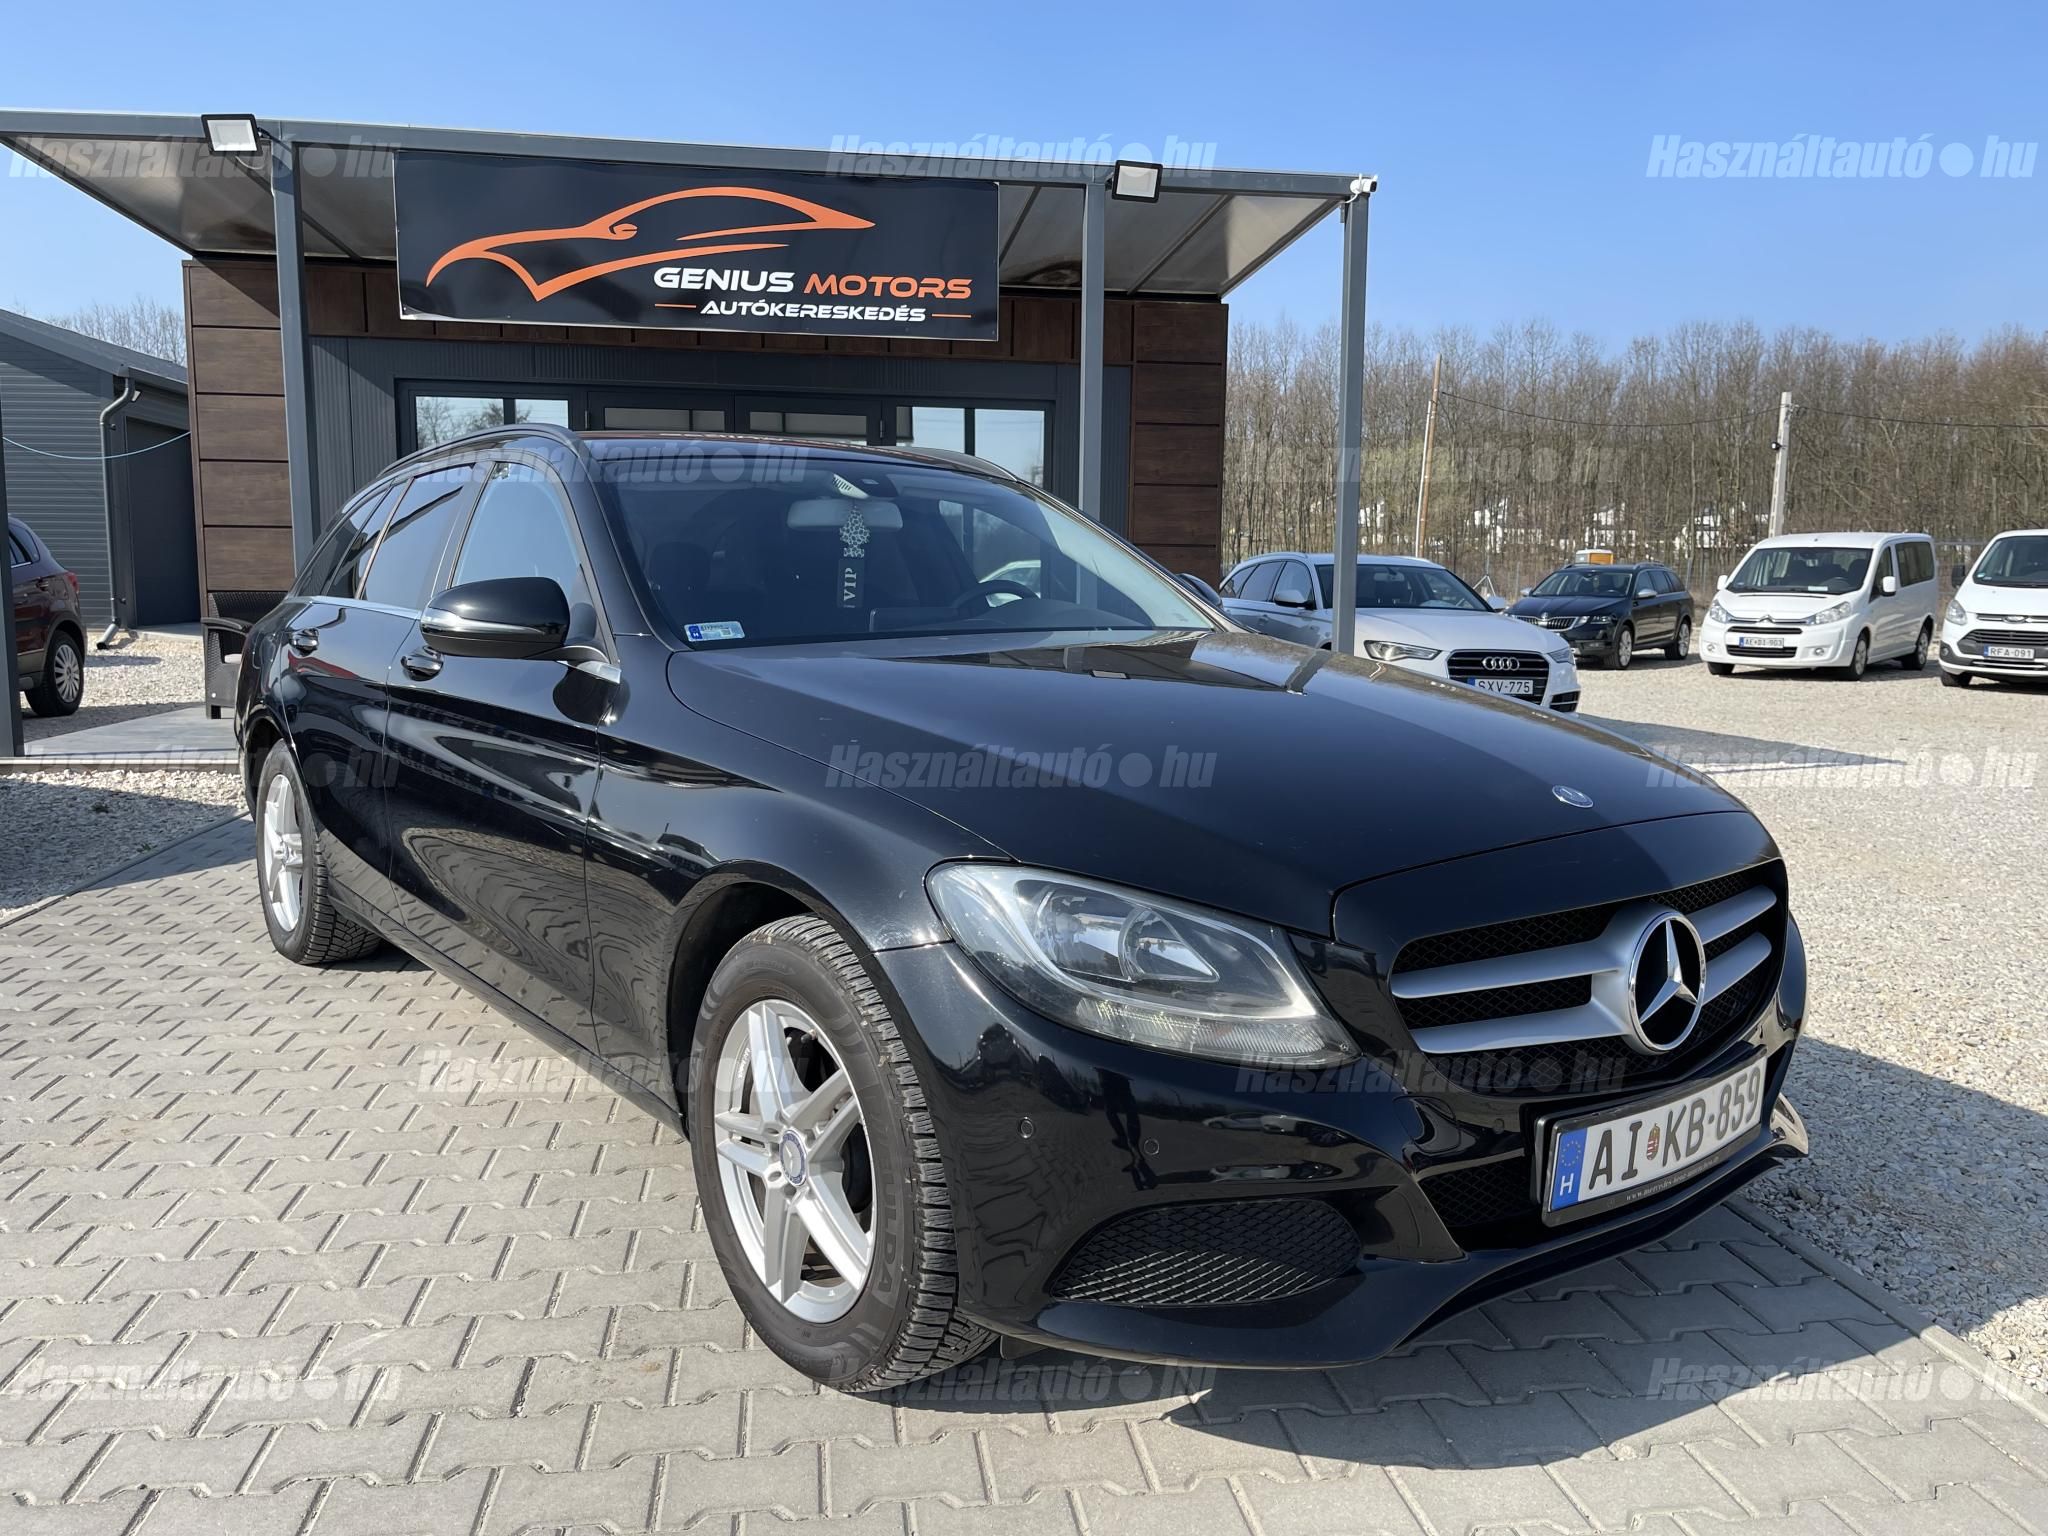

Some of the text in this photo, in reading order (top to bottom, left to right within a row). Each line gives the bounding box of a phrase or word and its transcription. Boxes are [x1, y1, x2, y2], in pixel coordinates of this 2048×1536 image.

[653, 266, 972, 300] GENIUS MOTORS
[700, 299, 926, 322] AUTÓKERESKEDÉS
